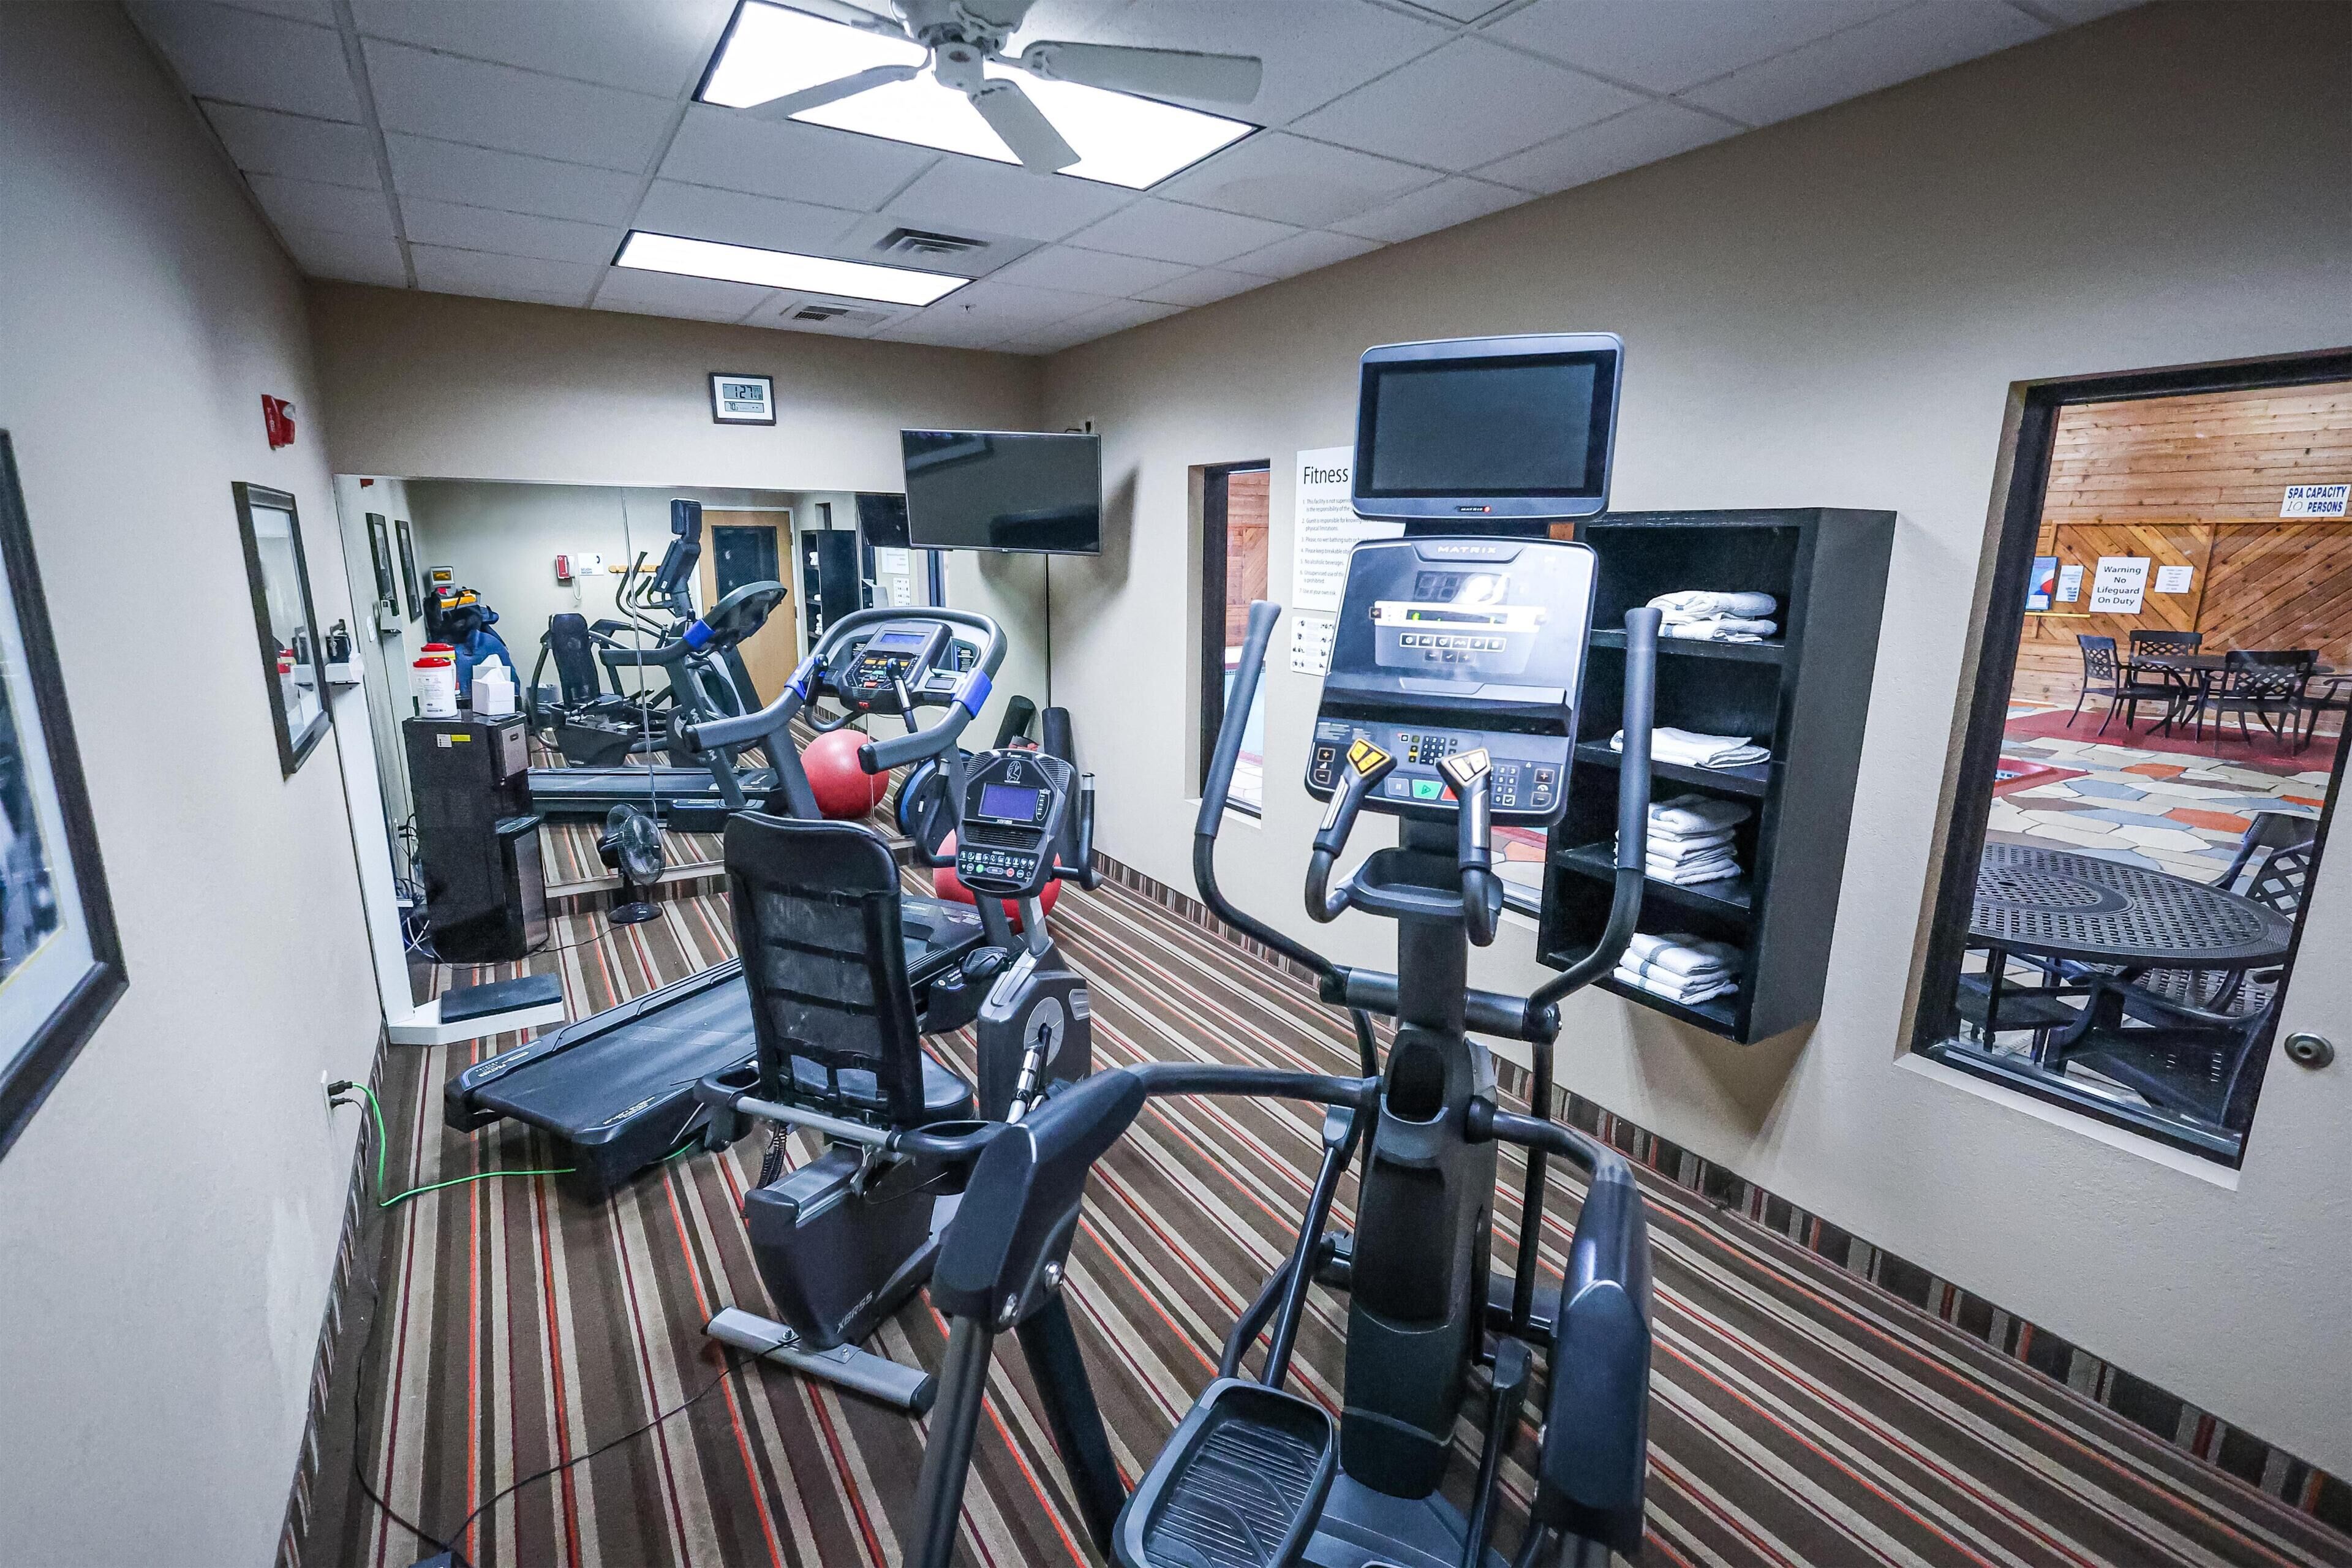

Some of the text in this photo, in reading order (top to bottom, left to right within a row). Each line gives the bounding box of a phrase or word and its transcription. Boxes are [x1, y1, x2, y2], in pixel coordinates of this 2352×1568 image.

[1304, 466, 1348, 484] Fitness
[2288, 486, 2347, 499] SPA CAPACITY
[2286, 501, 2343, 513] 10 PERSONS
[2104, 566, 2141, 575] Warning
[2097, 586, 2139, 595] Lifeguard
[2113, 597, 2135, 606] Duty
[837, 1290, 873, 1334] XBR55
